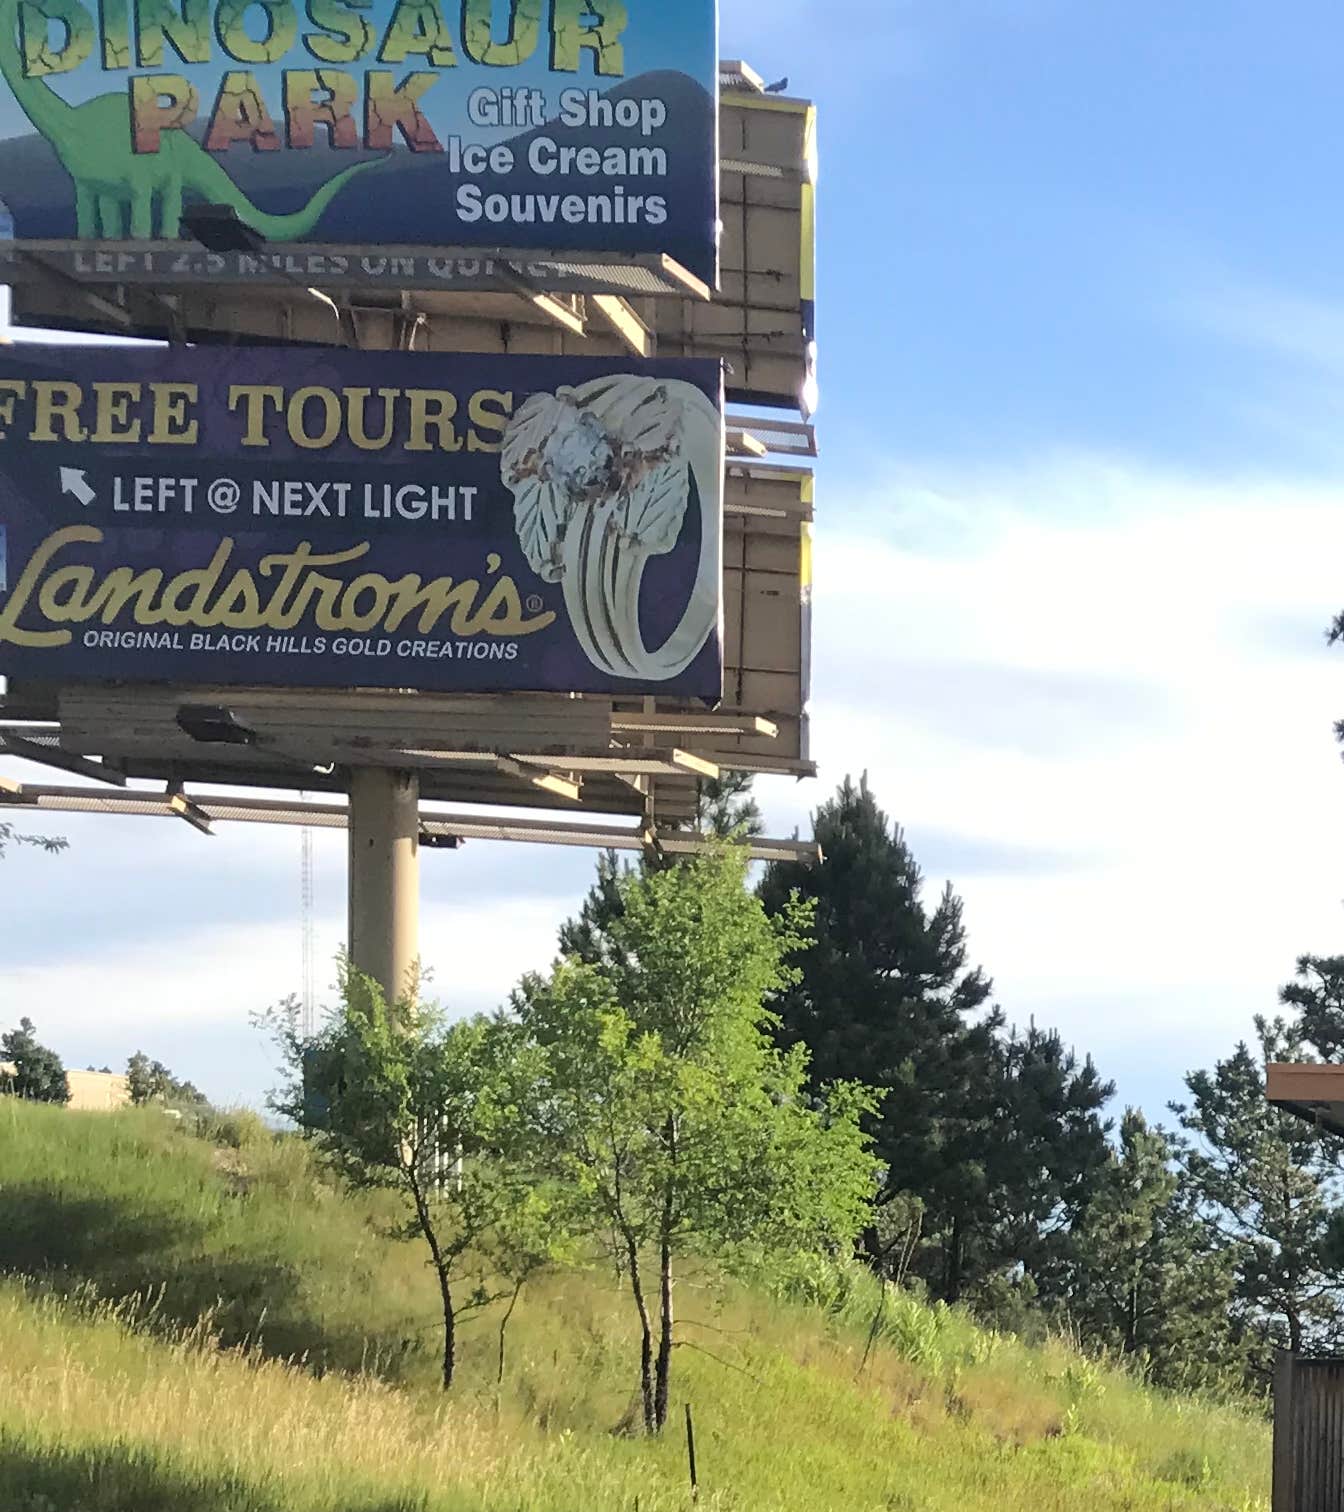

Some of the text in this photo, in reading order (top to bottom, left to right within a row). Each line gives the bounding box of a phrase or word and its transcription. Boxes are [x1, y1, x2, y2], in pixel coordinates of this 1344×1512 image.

[16, 0, 629, 79] DINOSAUR
[128, 67, 444, 154] PARK
[467, 87, 667, 136] Gift Shop
[448, 135, 668, 176] Ice Cream
[456, 183, 668, 224] Souvenirs
[228, 385, 514, 452] TOURS
[113, 476, 478, 521] LEFT @ NEXT LIGHT
[0, 525, 556, 648] Landstrom's
[83, 630, 519, 660] ORIGINAL BLACK HILLS GOLD CREATIONS
